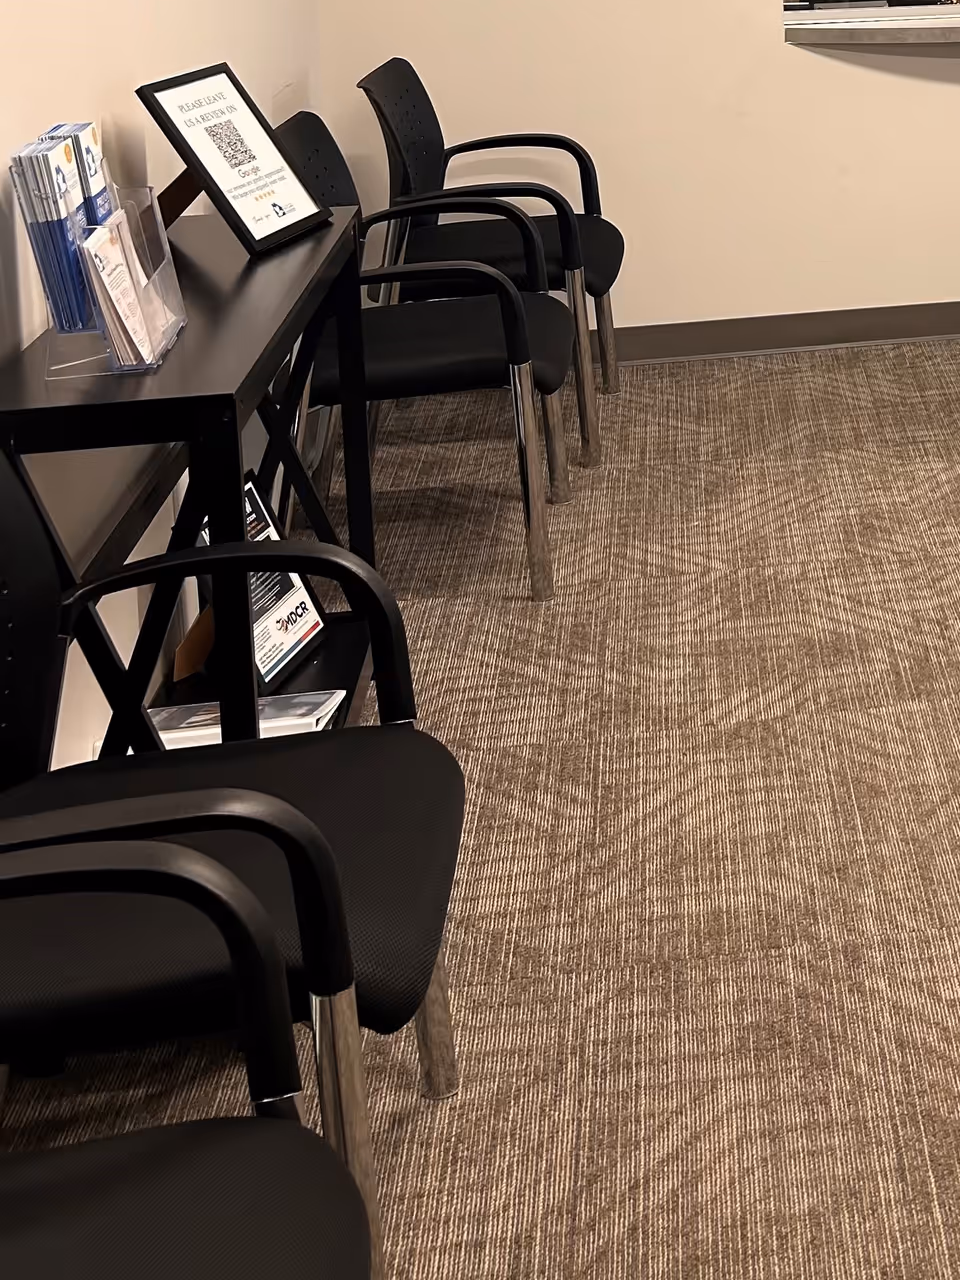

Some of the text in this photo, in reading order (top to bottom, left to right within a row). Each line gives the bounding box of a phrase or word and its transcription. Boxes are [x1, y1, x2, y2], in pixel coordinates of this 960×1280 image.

[178, 91, 227, 114] PLEASE LEAVE
[184, 104, 238, 128] US A REVIEW ON
[238, 165, 261, 179] Google
[285, 600, 310, 628] MDCR
